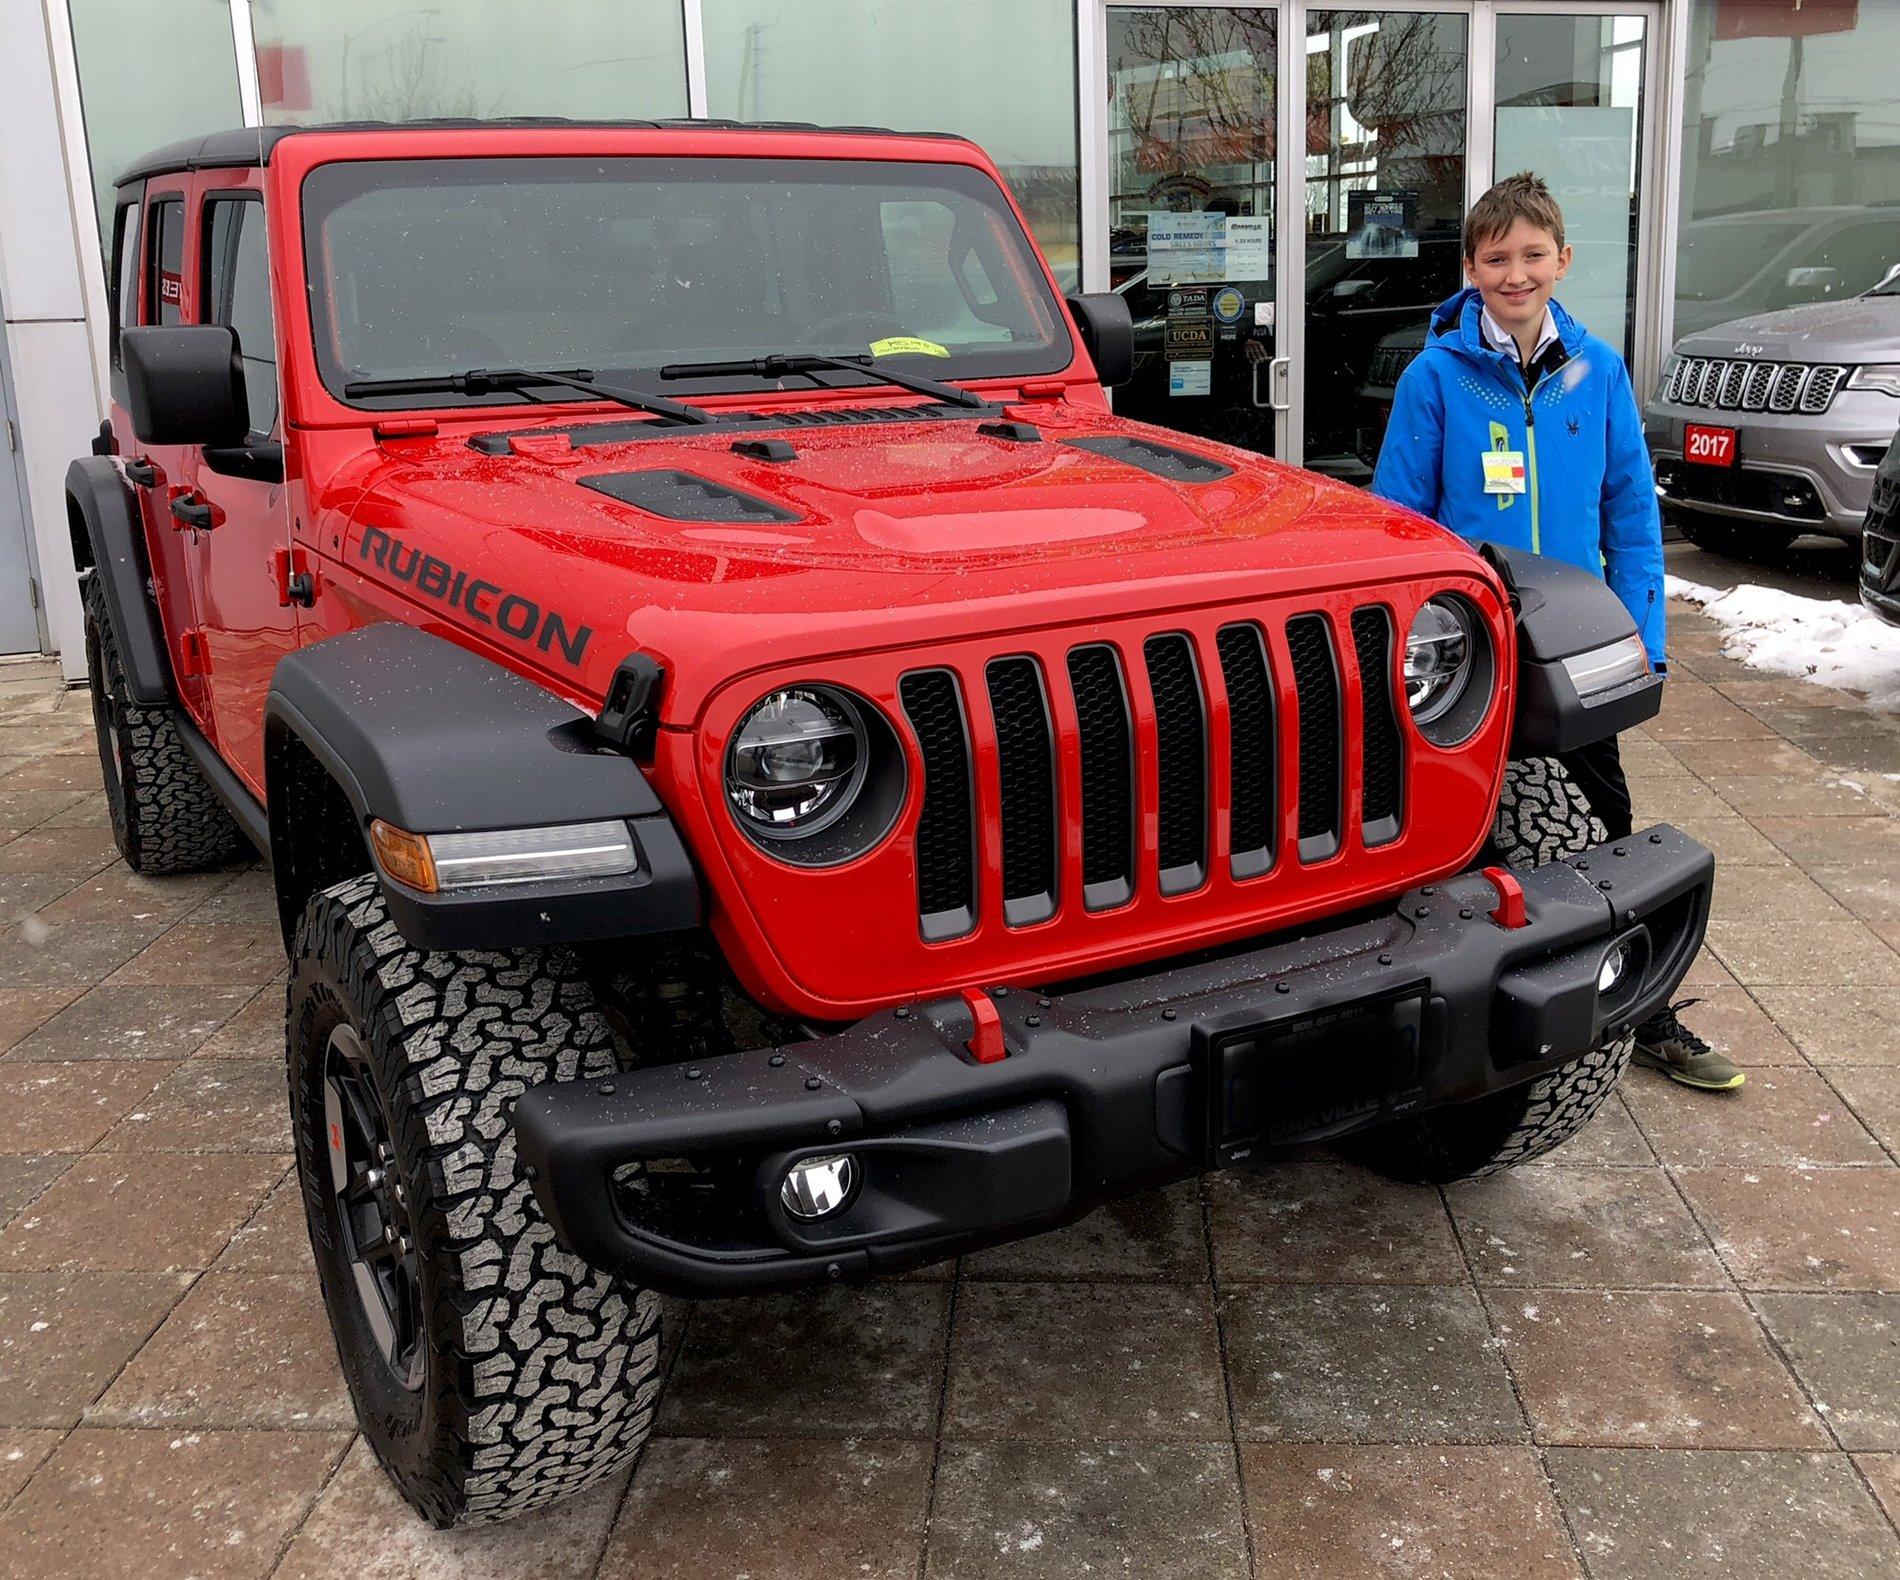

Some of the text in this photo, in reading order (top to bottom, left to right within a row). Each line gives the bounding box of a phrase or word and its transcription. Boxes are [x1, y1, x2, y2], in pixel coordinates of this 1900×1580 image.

[1151, 232, 1204, 241] COLD REMEDY
[1182, 294, 1205, 302] TADA
[1172, 331, 1207, 341] UCDA
[1734, 342, 1763, 357] Jeep
[1689, 433, 1730, 458] 2017
[359, 524, 593, 666] RUBICON
[1230, 1149, 1251, 1161] Jeep
